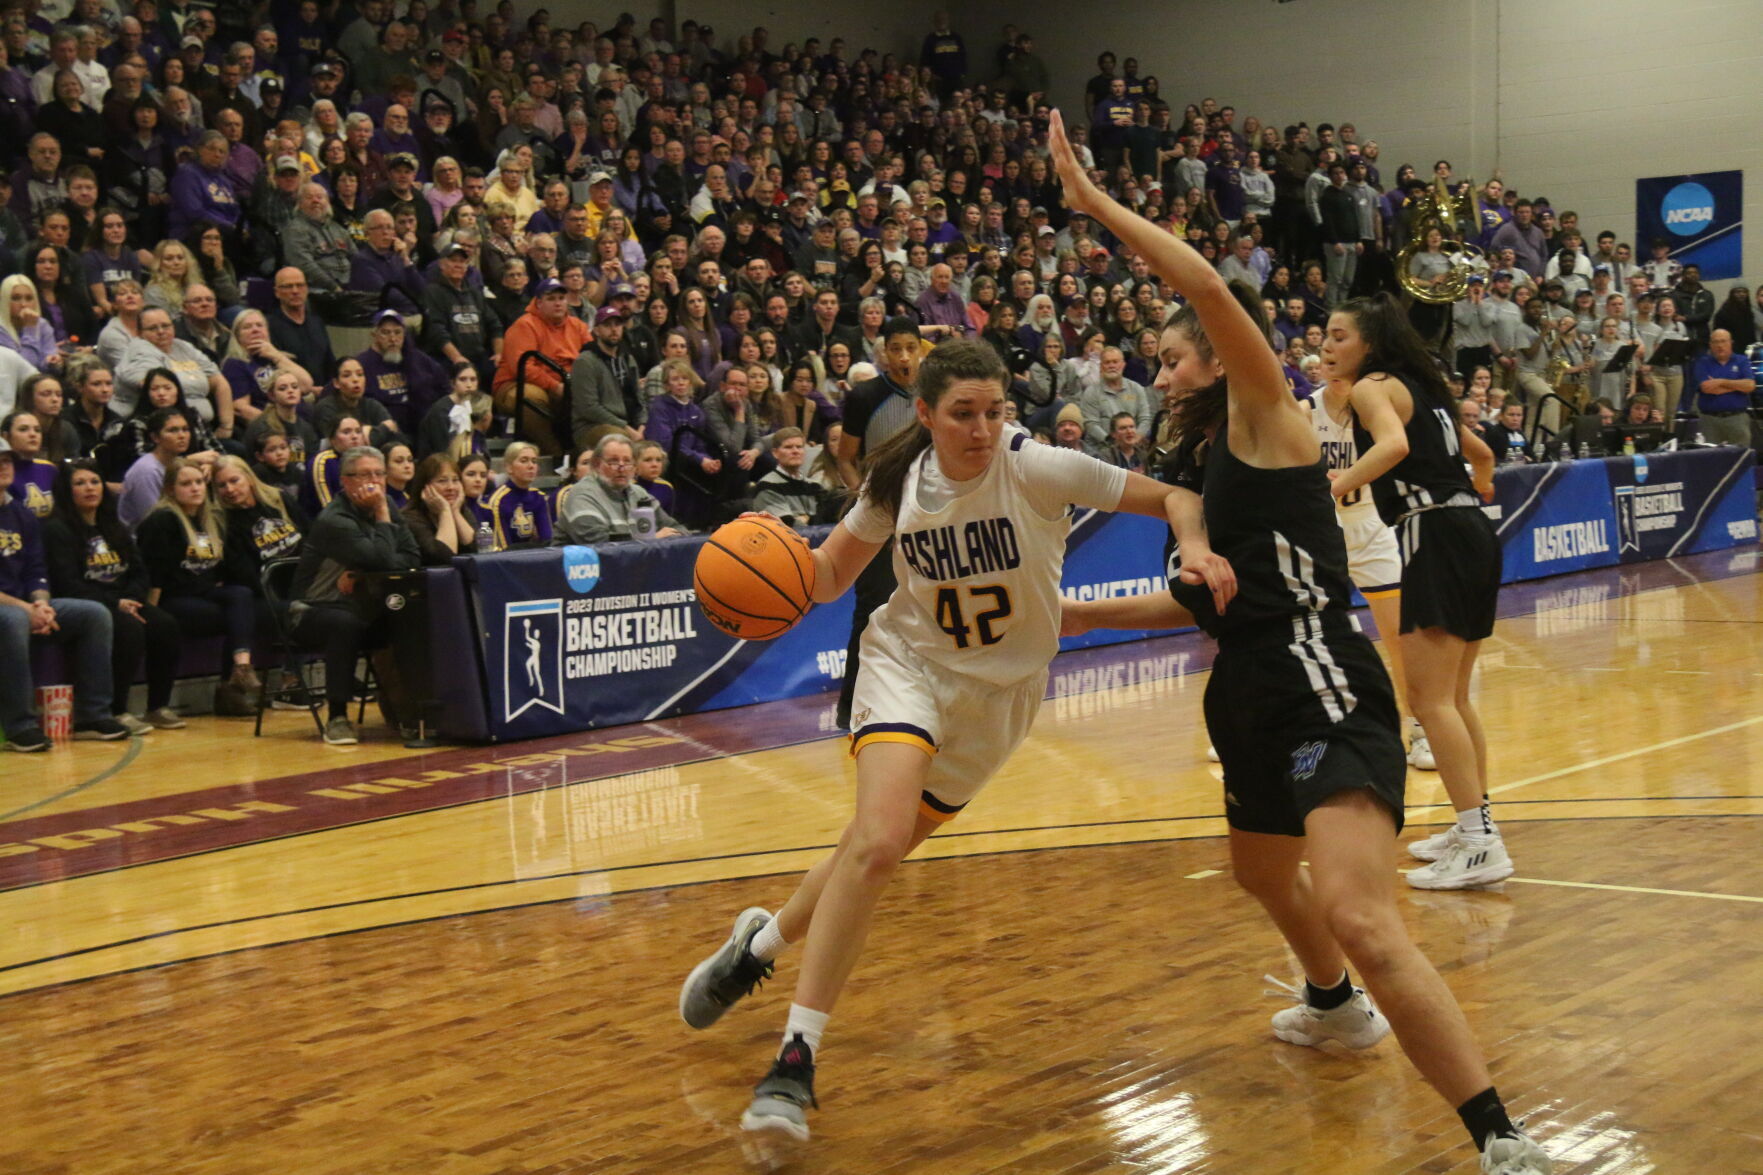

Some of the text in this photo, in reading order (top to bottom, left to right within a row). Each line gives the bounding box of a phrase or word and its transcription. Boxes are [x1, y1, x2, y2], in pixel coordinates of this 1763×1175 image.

[1665, 206, 1713, 224] NCAA
[900, 517, 1021, 581] ASHLAND
[1533, 519, 1609, 563] BASKETBALL
[567, 563, 600, 580] NCAA
[566, 588, 696, 614] 2023 DIVISION II WOMEN'S
[935, 583, 1014, 650] 42
[566, 607, 697, 652] BASKETBALL
[565, 644, 677, 679] CHAMPIONSHIP
[305, 735, 689, 800] Sherrill
